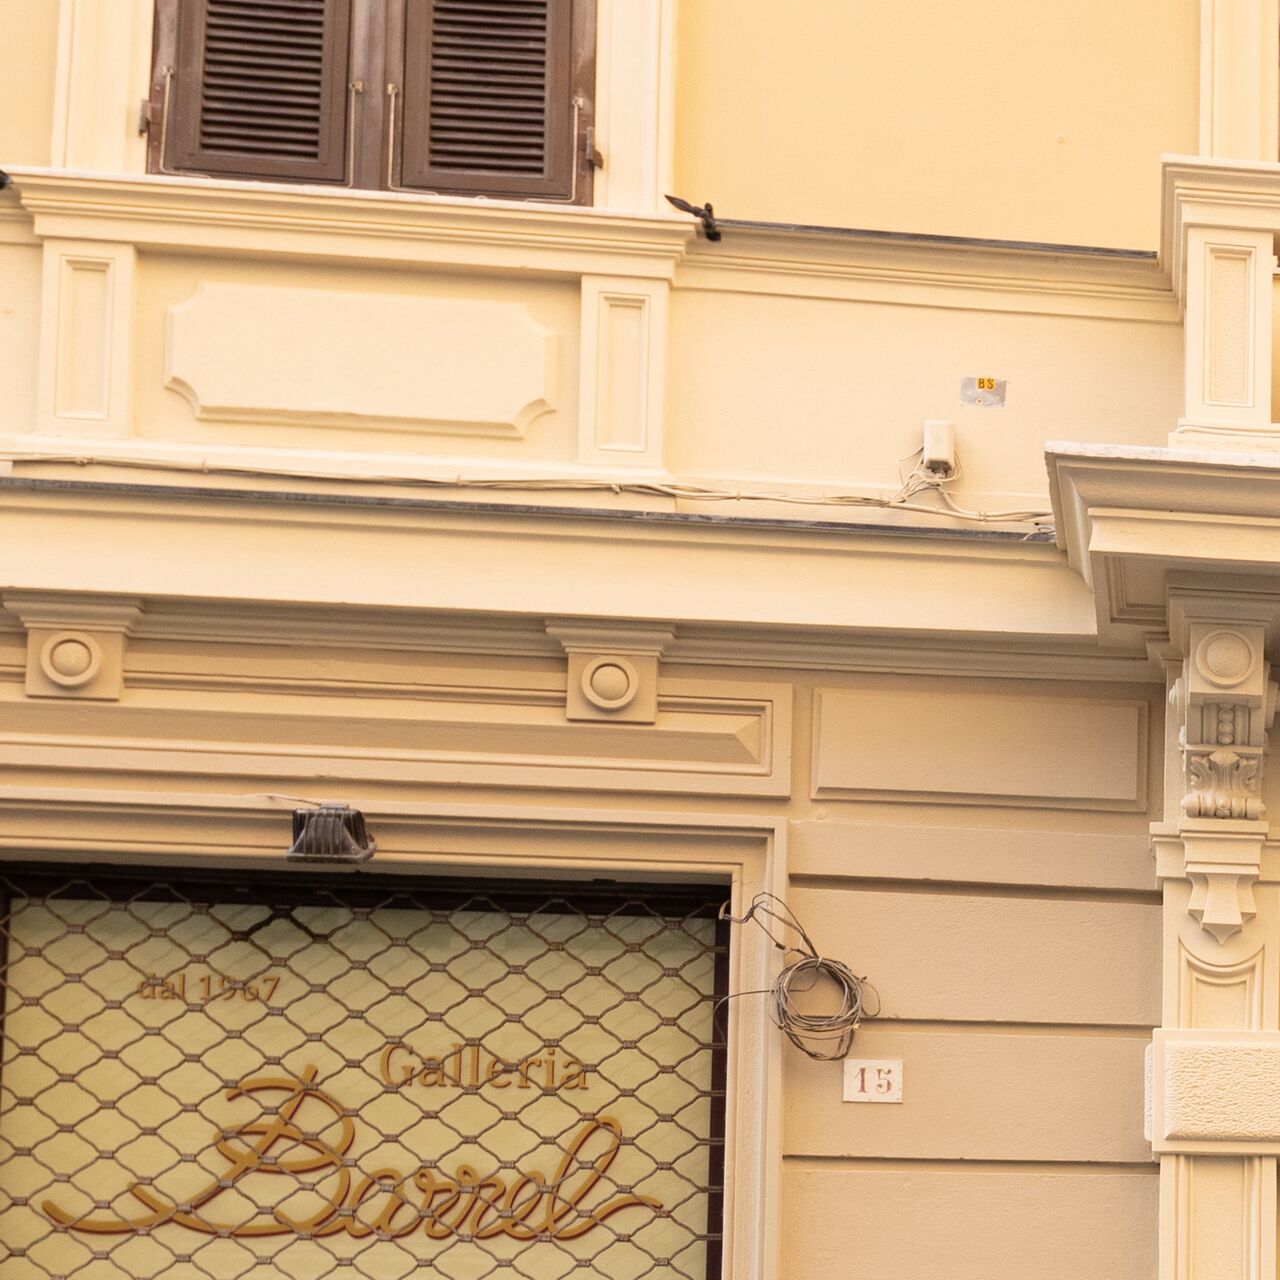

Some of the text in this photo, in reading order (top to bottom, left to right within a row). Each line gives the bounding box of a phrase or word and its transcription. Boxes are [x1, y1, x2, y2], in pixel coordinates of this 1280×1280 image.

[137, 973, 187, 1001] dal
[379, 1042, 590, 1091] Galleria
[854, 1067, 893, 1094] 15
